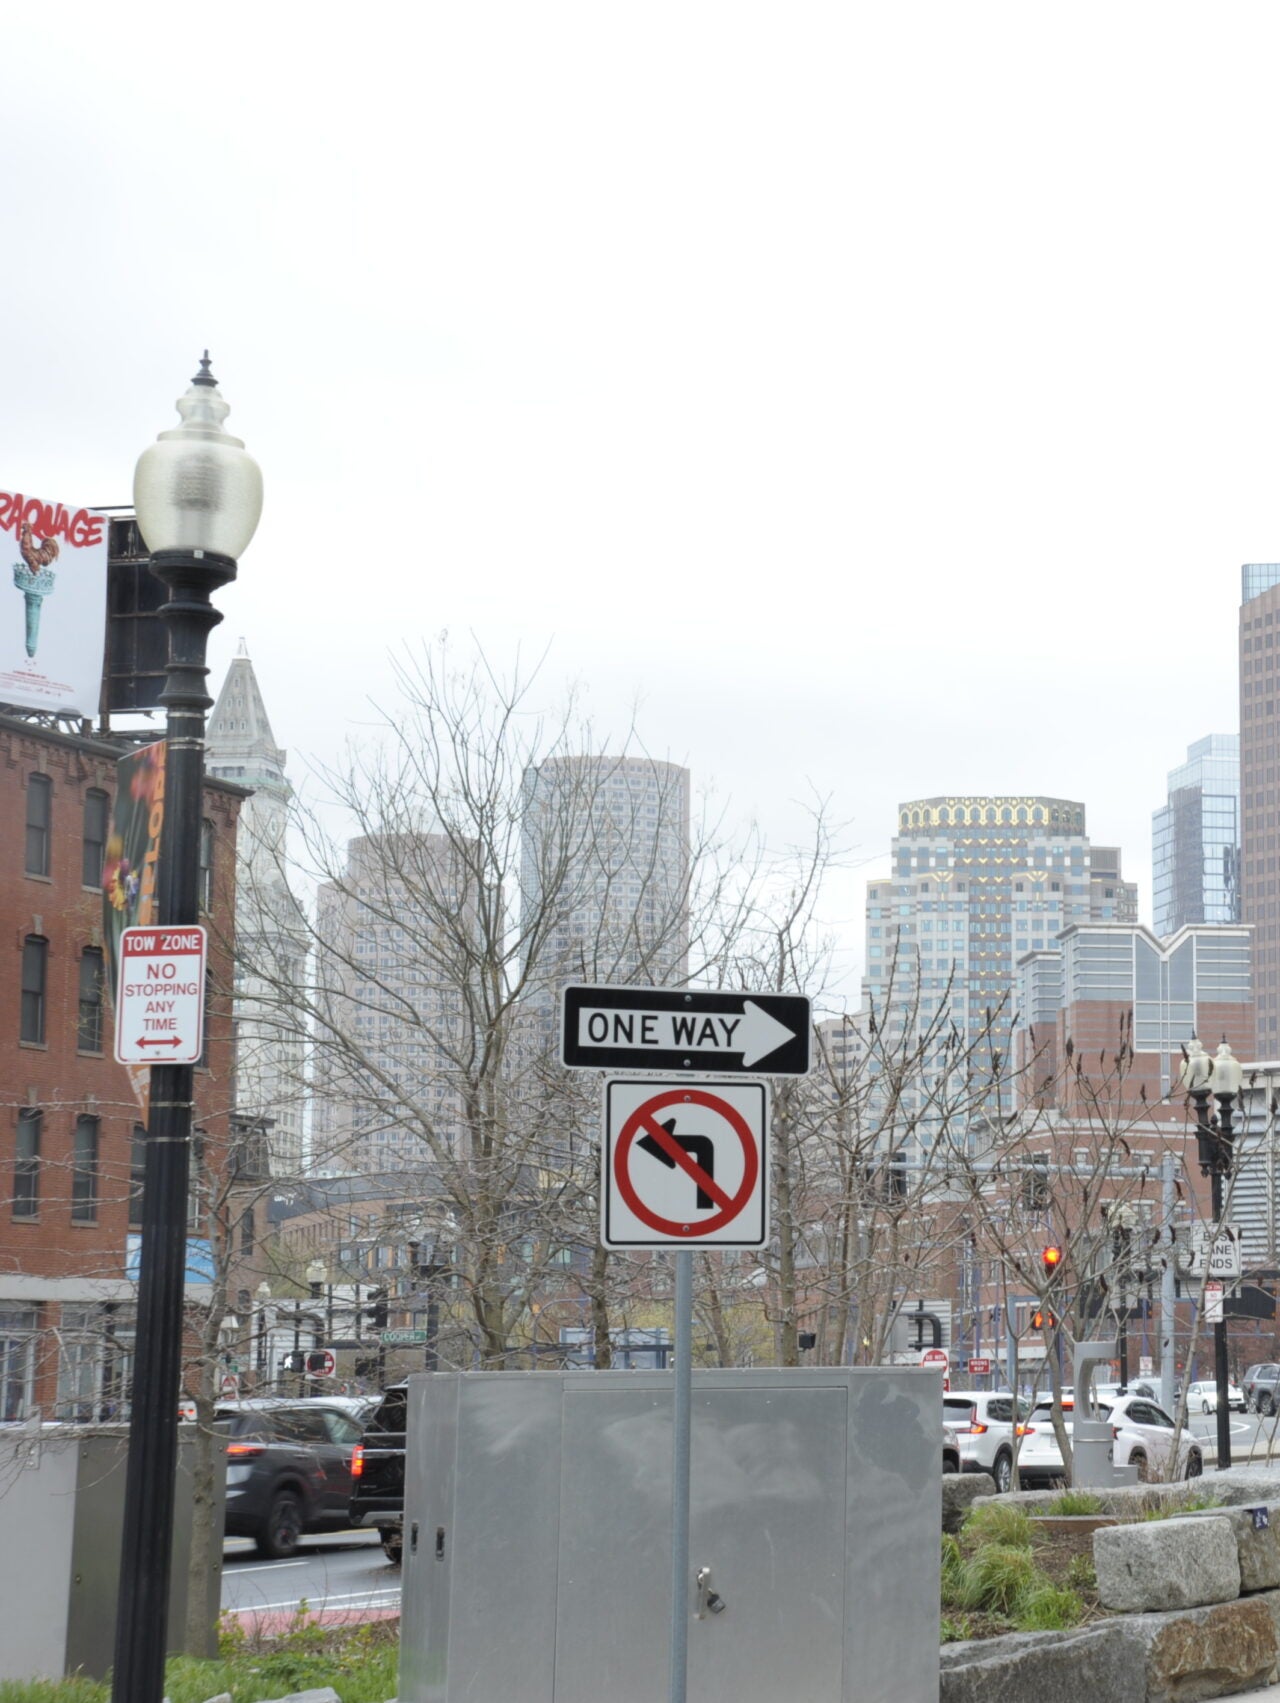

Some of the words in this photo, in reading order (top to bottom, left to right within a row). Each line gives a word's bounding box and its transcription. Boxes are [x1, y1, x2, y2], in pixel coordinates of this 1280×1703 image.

[126, 936, 156, 951] TOW
[160, 934, 200, 950] ZONE
[146, 963, 176, 980] NO
[125, 982, 198, 997] STOPPING
[145, 1000, 175, 1014] ANY
[143, 1018, 177, 1031] TIME
[588, 1012, 659, 1045] ONE
[671, 1016, 741, 1048] WAY
[1203, 1231, 1228, 1241] BS
